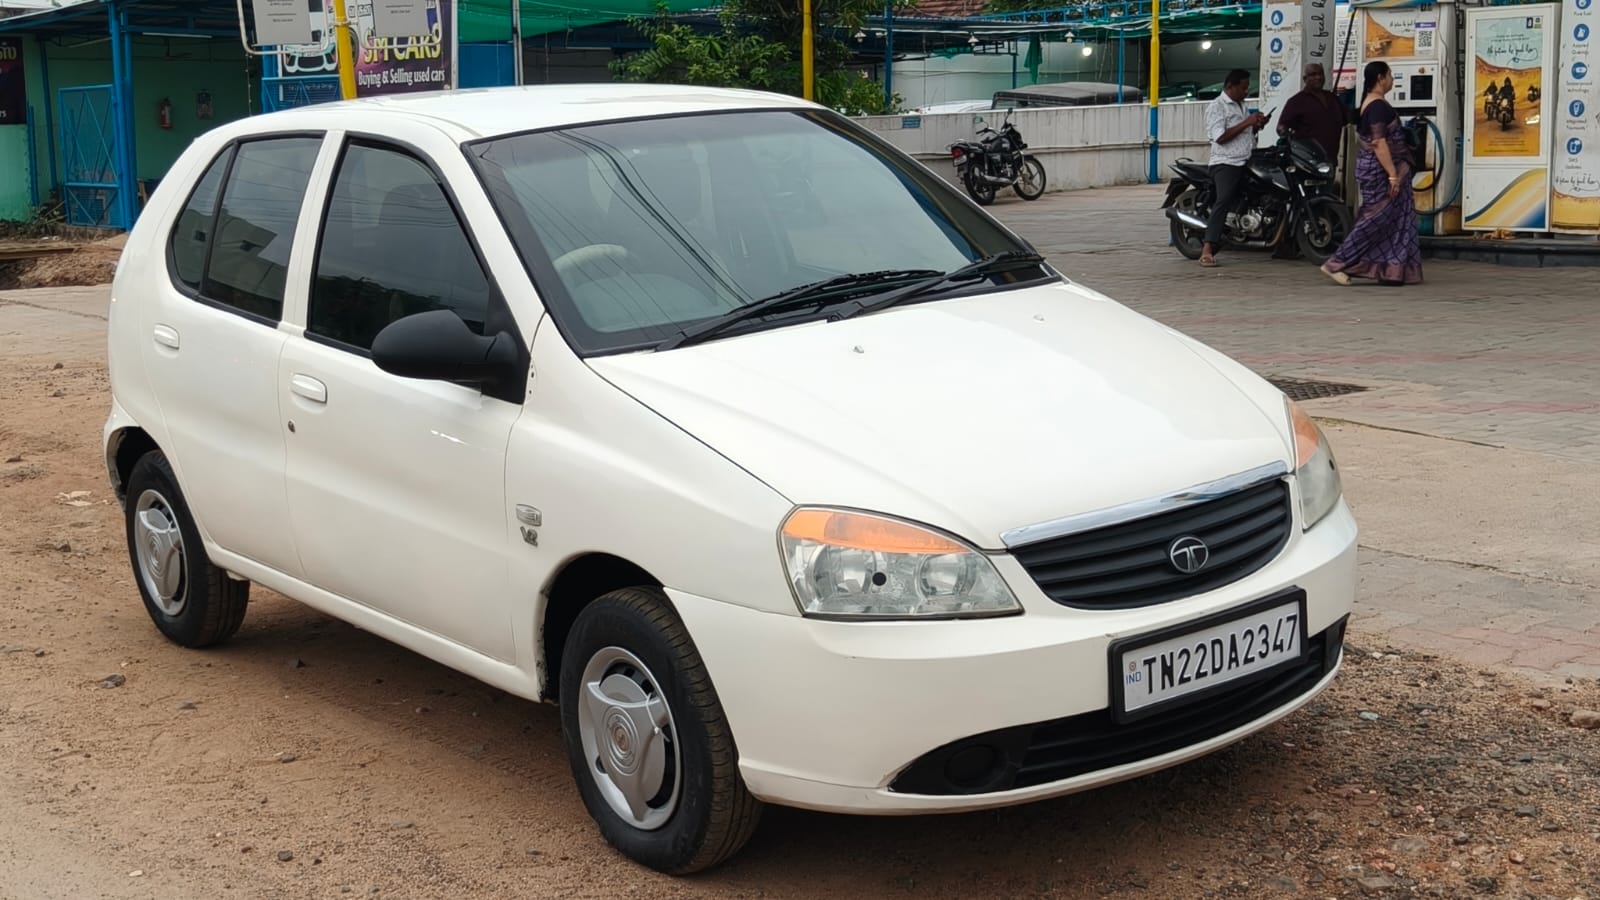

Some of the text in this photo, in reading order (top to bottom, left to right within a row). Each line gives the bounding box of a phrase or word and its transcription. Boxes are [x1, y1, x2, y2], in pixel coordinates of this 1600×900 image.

[358, 66, 445, 88] Buying & Selling used cars
[1143, 614, 1298, 694] TN22DA2347
[1125, 671, 1142, 686] IND
